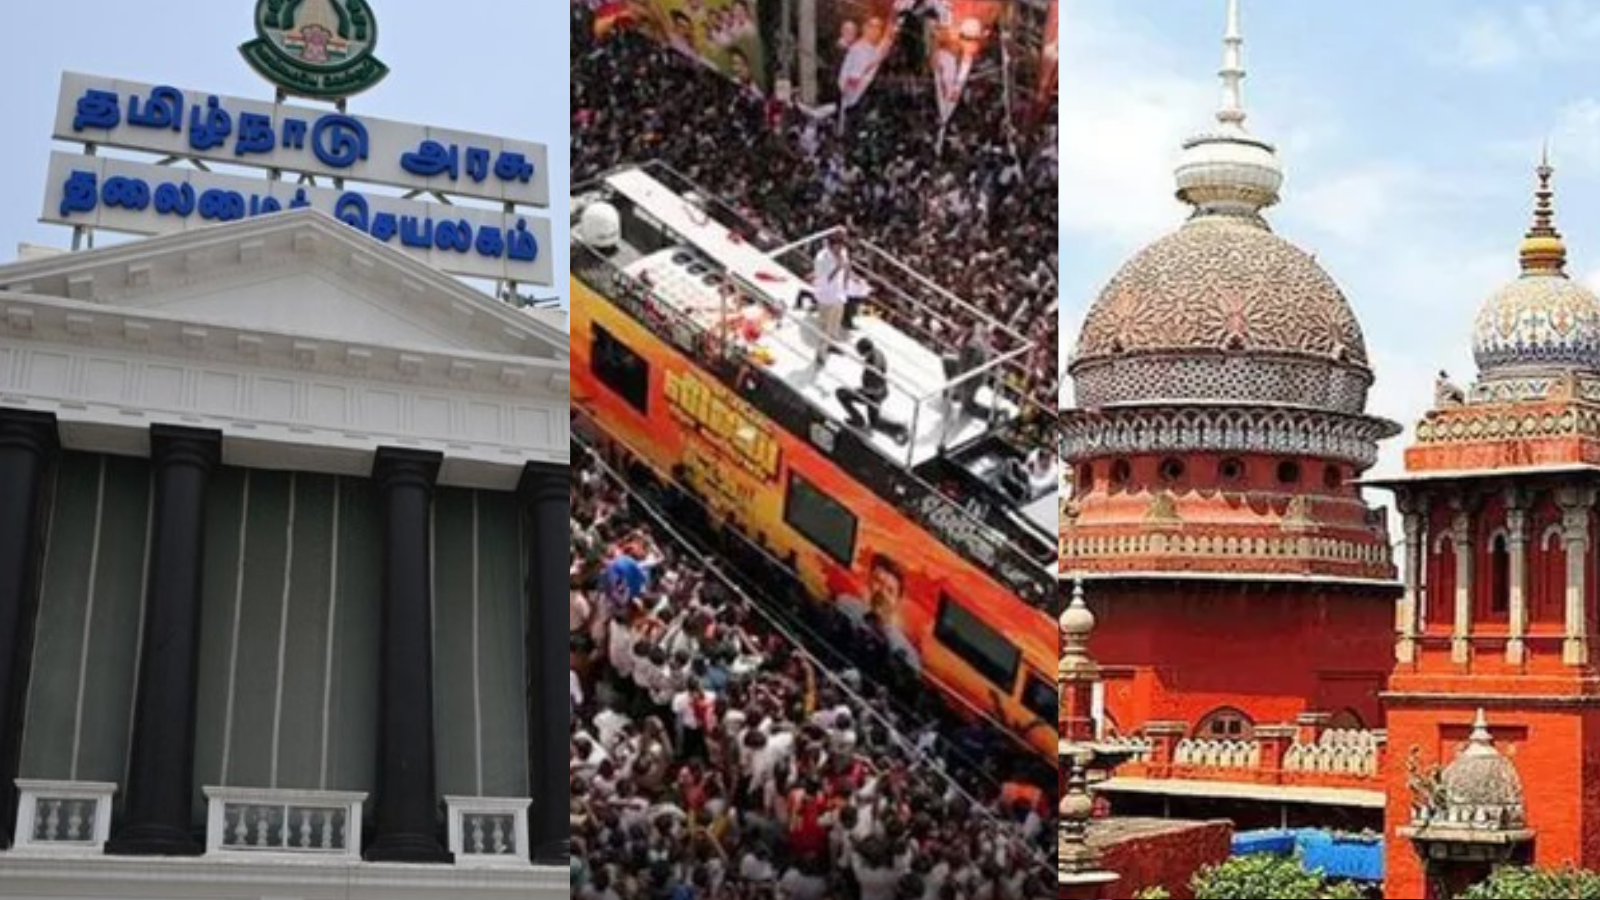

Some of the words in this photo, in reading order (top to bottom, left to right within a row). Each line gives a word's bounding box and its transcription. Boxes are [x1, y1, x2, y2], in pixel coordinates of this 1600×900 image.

[73, 85, 369, 168] தமிழ்நாடு
[400, 140, 533, 183] அரசு
[335, 191, 538, 262] செயலகம்
